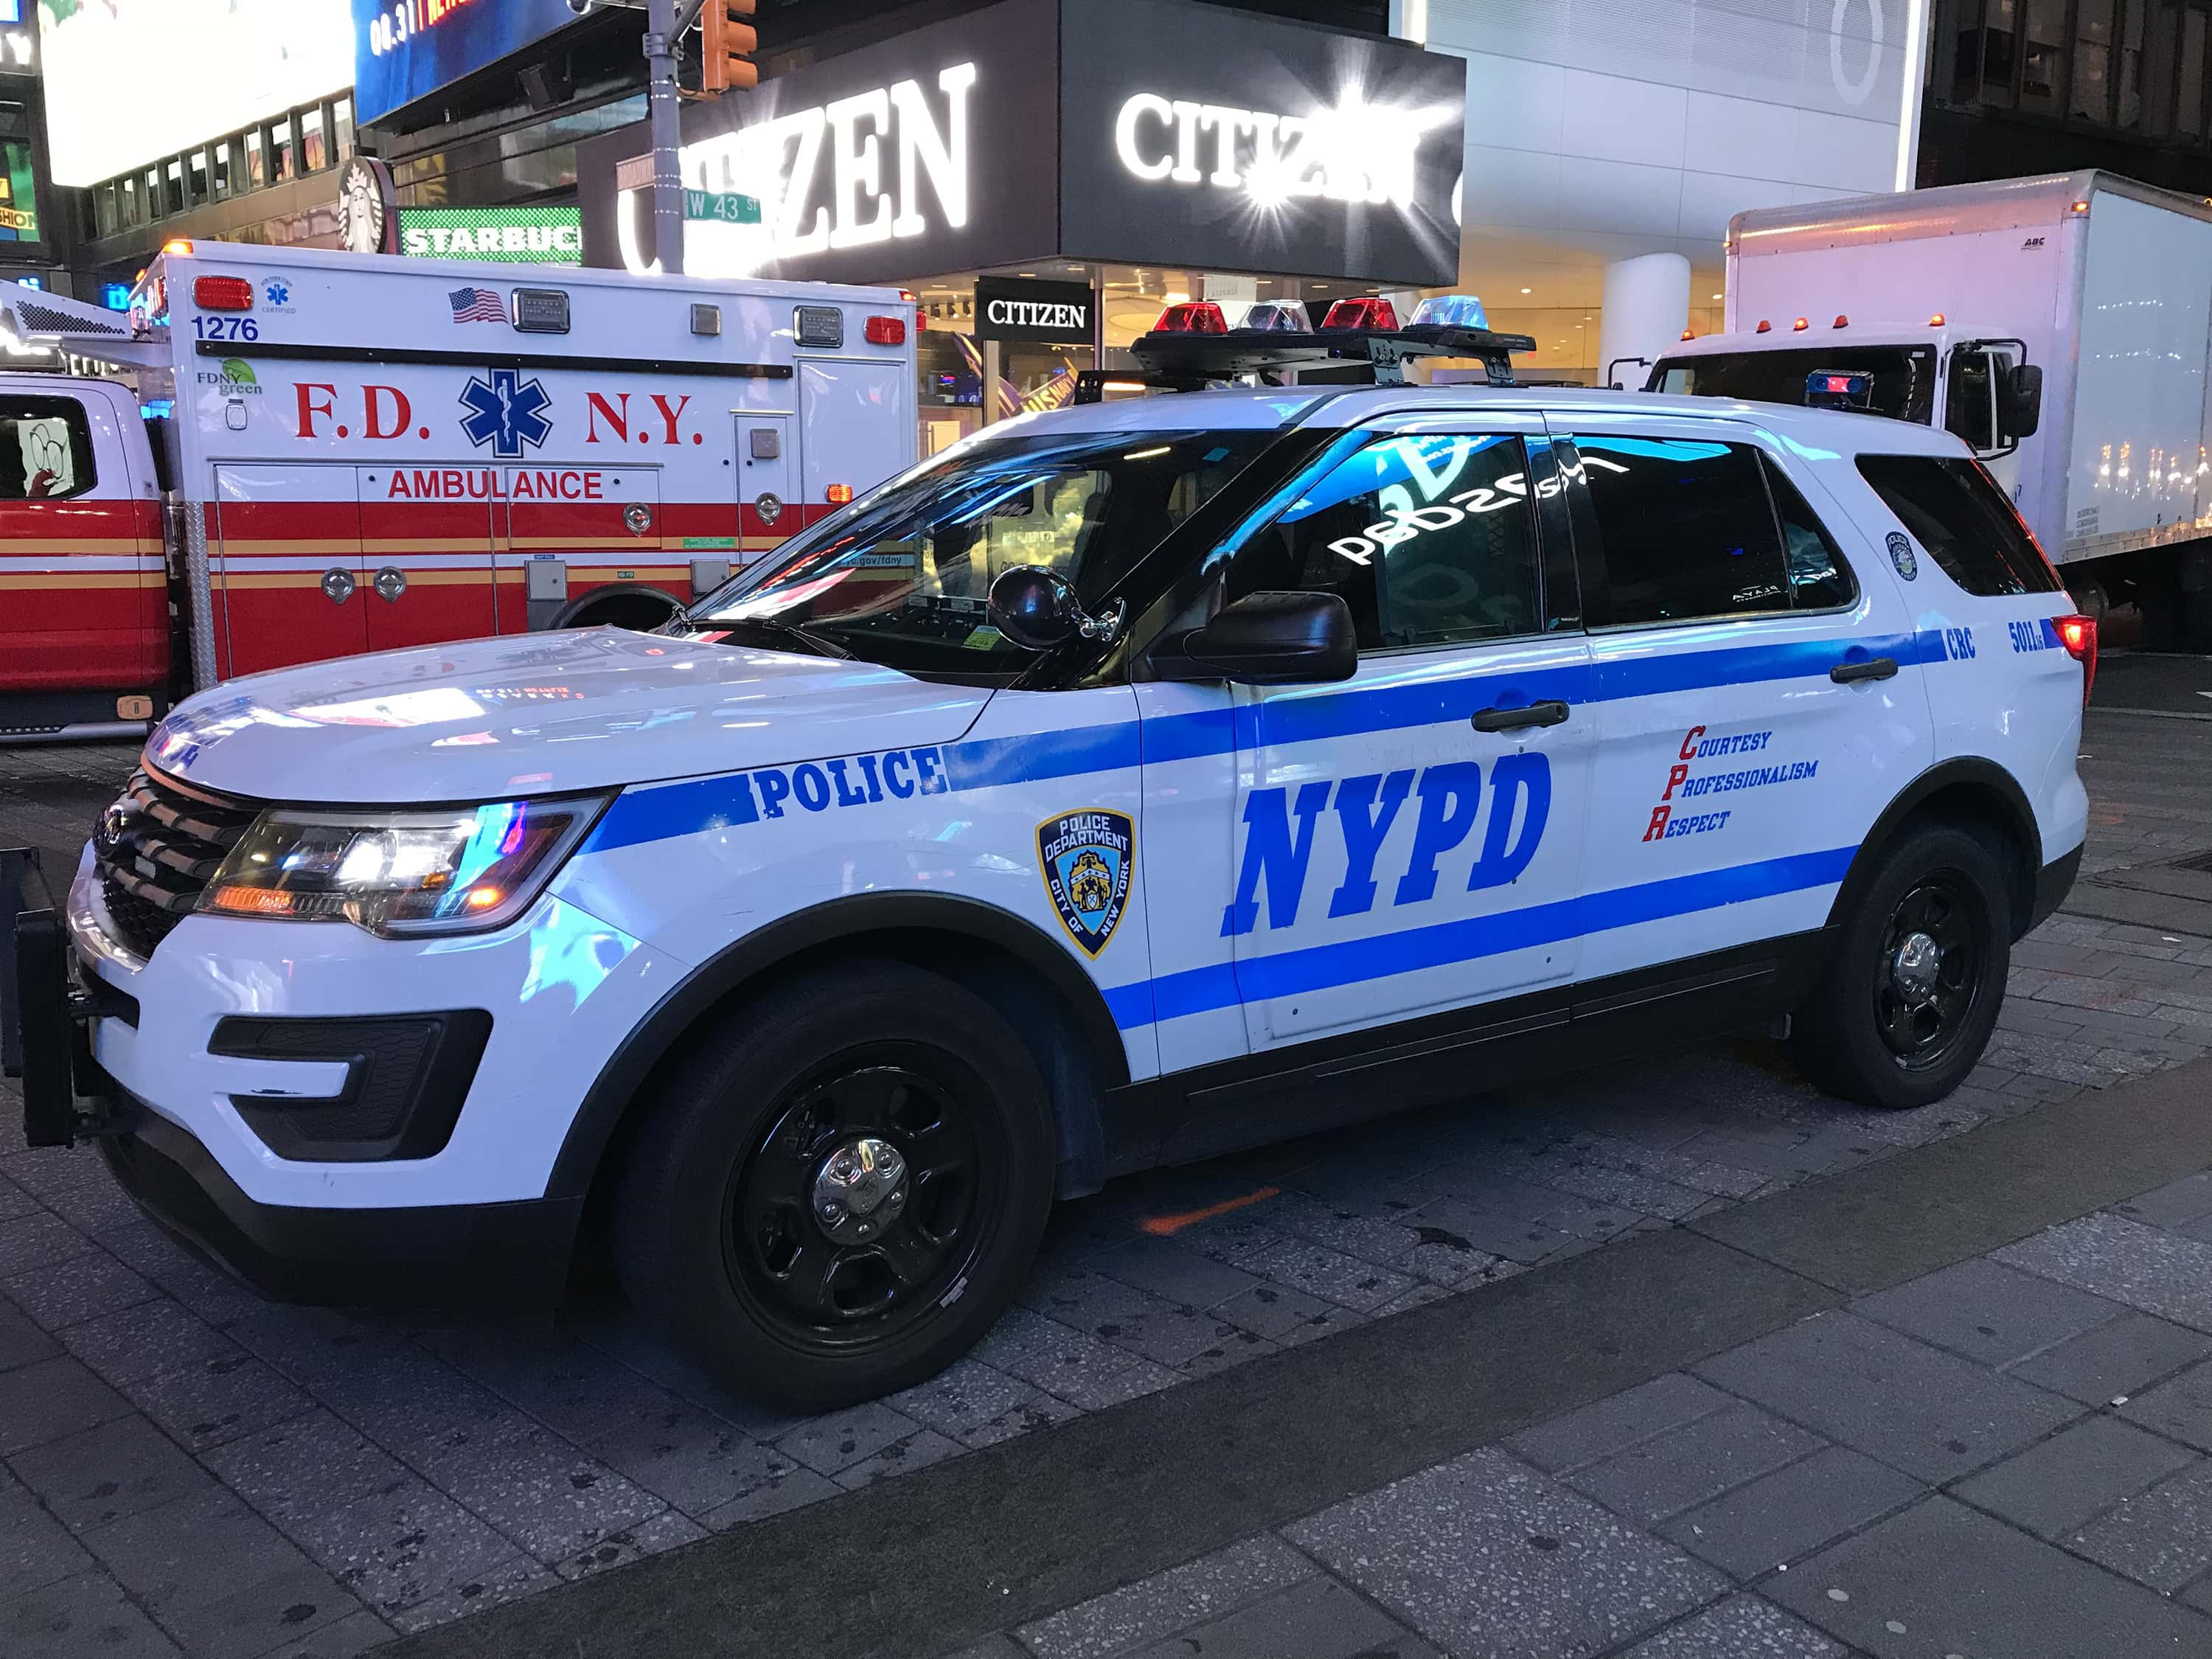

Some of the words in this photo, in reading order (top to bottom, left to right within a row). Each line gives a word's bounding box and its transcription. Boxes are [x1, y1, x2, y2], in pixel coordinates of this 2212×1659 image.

[617, 62, 975, 276] CTIZEN
[689, 192, 705, 217] W
[713, 195, 739, 220] 43
[746, 198, 757, 212] ST
[406, 226, 583, 254] STARBUC
[191, 316, 259, 341] 1276
[987, 299, 1086, 329] CITIZEN
[197, 372, 242, 385] FDNY
[219, 384, 263, 397] green
[293, 382, 430, 439] F.D.
[585, 392, 703, 445] N.Y.
[387, 470, 605, 499] AMBULANCE
[845, 555, 902, 567] yc.gov/fdny
[1946, 626, 1976, 661] CRC
[1678, 725, 1773, 761] COURTESY
[754, 746, 949, 820] POLICE
[1661, 760, 1819, 801] PROFESSIONALISM
[1059, 814, 1110, 836] POLICE
[1641, 805, 1732, 843] RESPECT
[1044, 830, 1128, 863] DEPARTMENT
[1220, 752, 1552, 938] NYPD
[1050, 878, 1071, 913] CITY
[1068, 915, 1084, 934] OF
[1100, 904, 1120, 937] NEW
[1115, 860, 1130, 899] YORK
